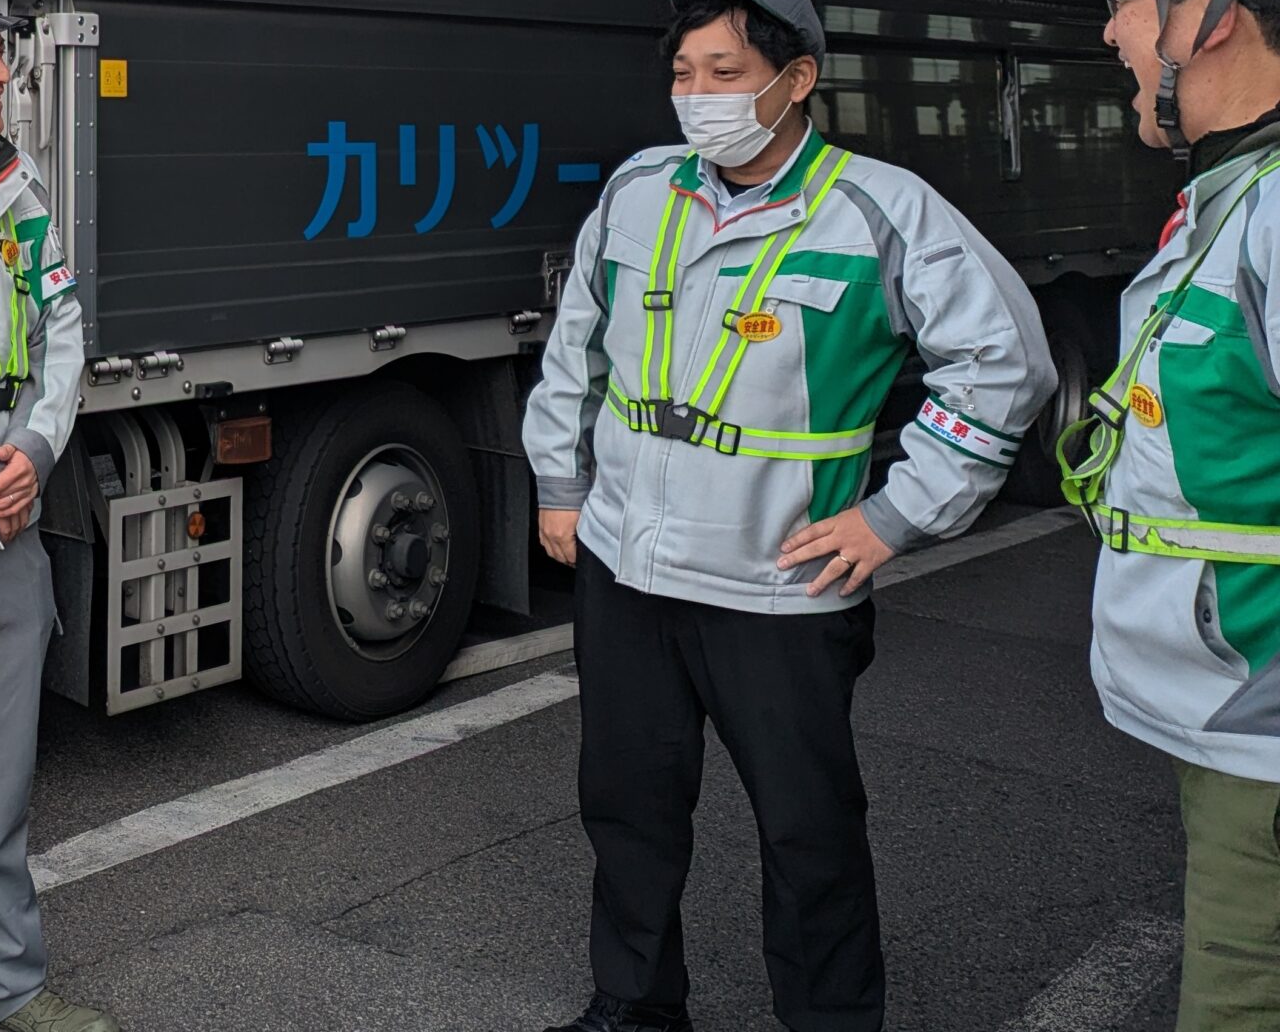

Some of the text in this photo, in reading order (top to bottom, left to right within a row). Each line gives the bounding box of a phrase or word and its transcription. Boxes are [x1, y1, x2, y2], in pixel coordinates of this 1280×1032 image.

[303, 121, 601, 241] カリツー
[744, 320, 775, 333] 安全宣言
[922, 401, 991, 446] 安全第一
